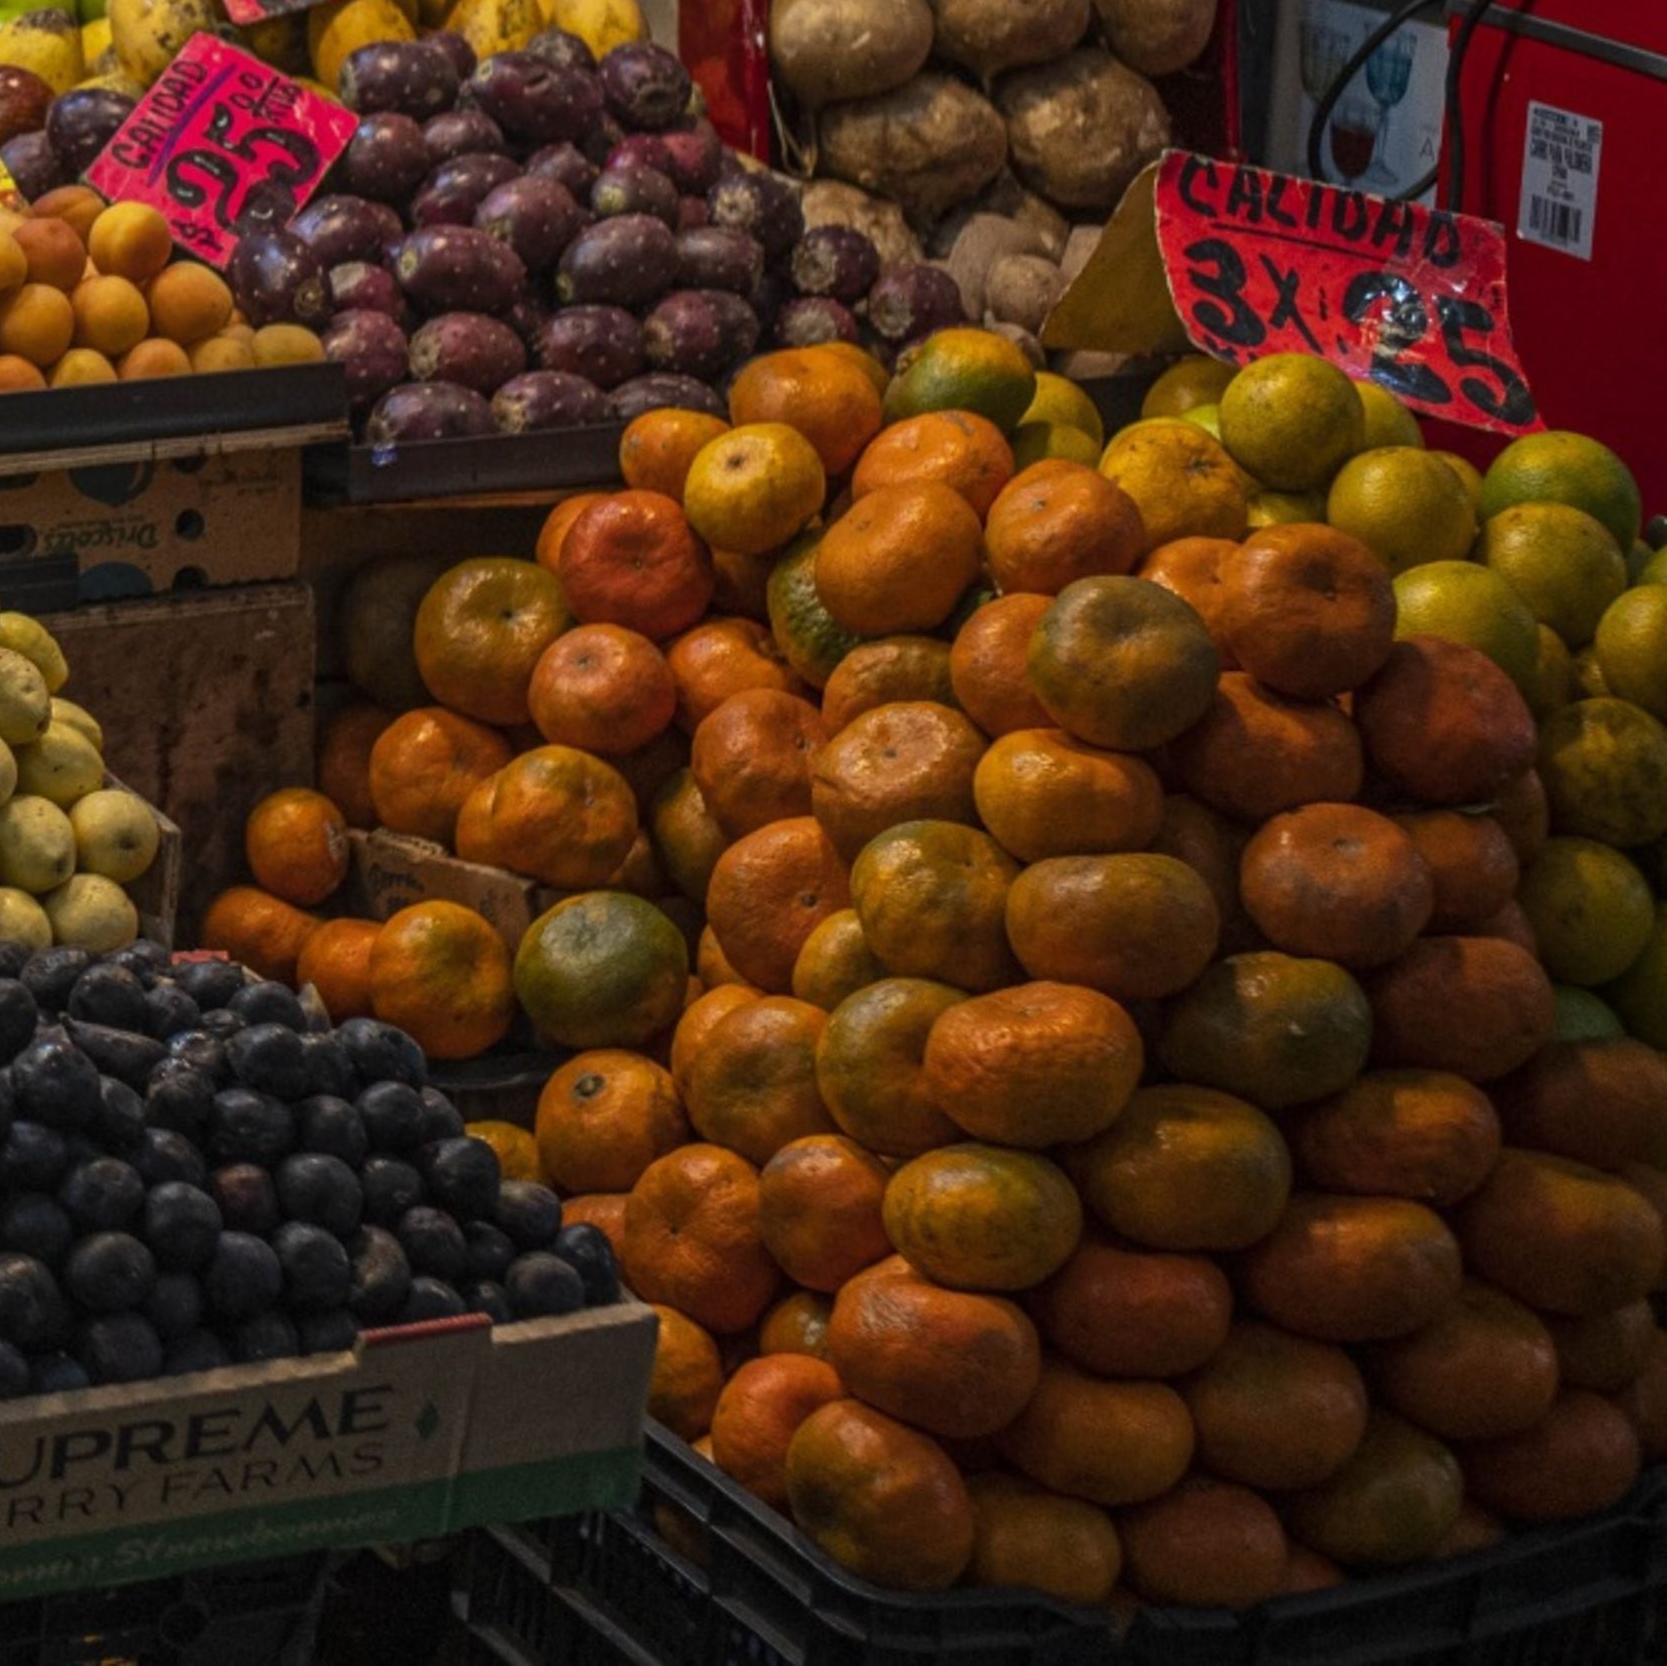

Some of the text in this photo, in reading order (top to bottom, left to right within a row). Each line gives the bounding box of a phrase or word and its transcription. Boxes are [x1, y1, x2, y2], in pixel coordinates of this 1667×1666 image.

[111, 60, 208, 169] CALIDAD
[167, 102, 323, 236] 25
[1177, 156, 1462, 269] CALIDAD
[1341, 270, 1537, 427] 25
[160, 1440, 388, 1505] FARMS
